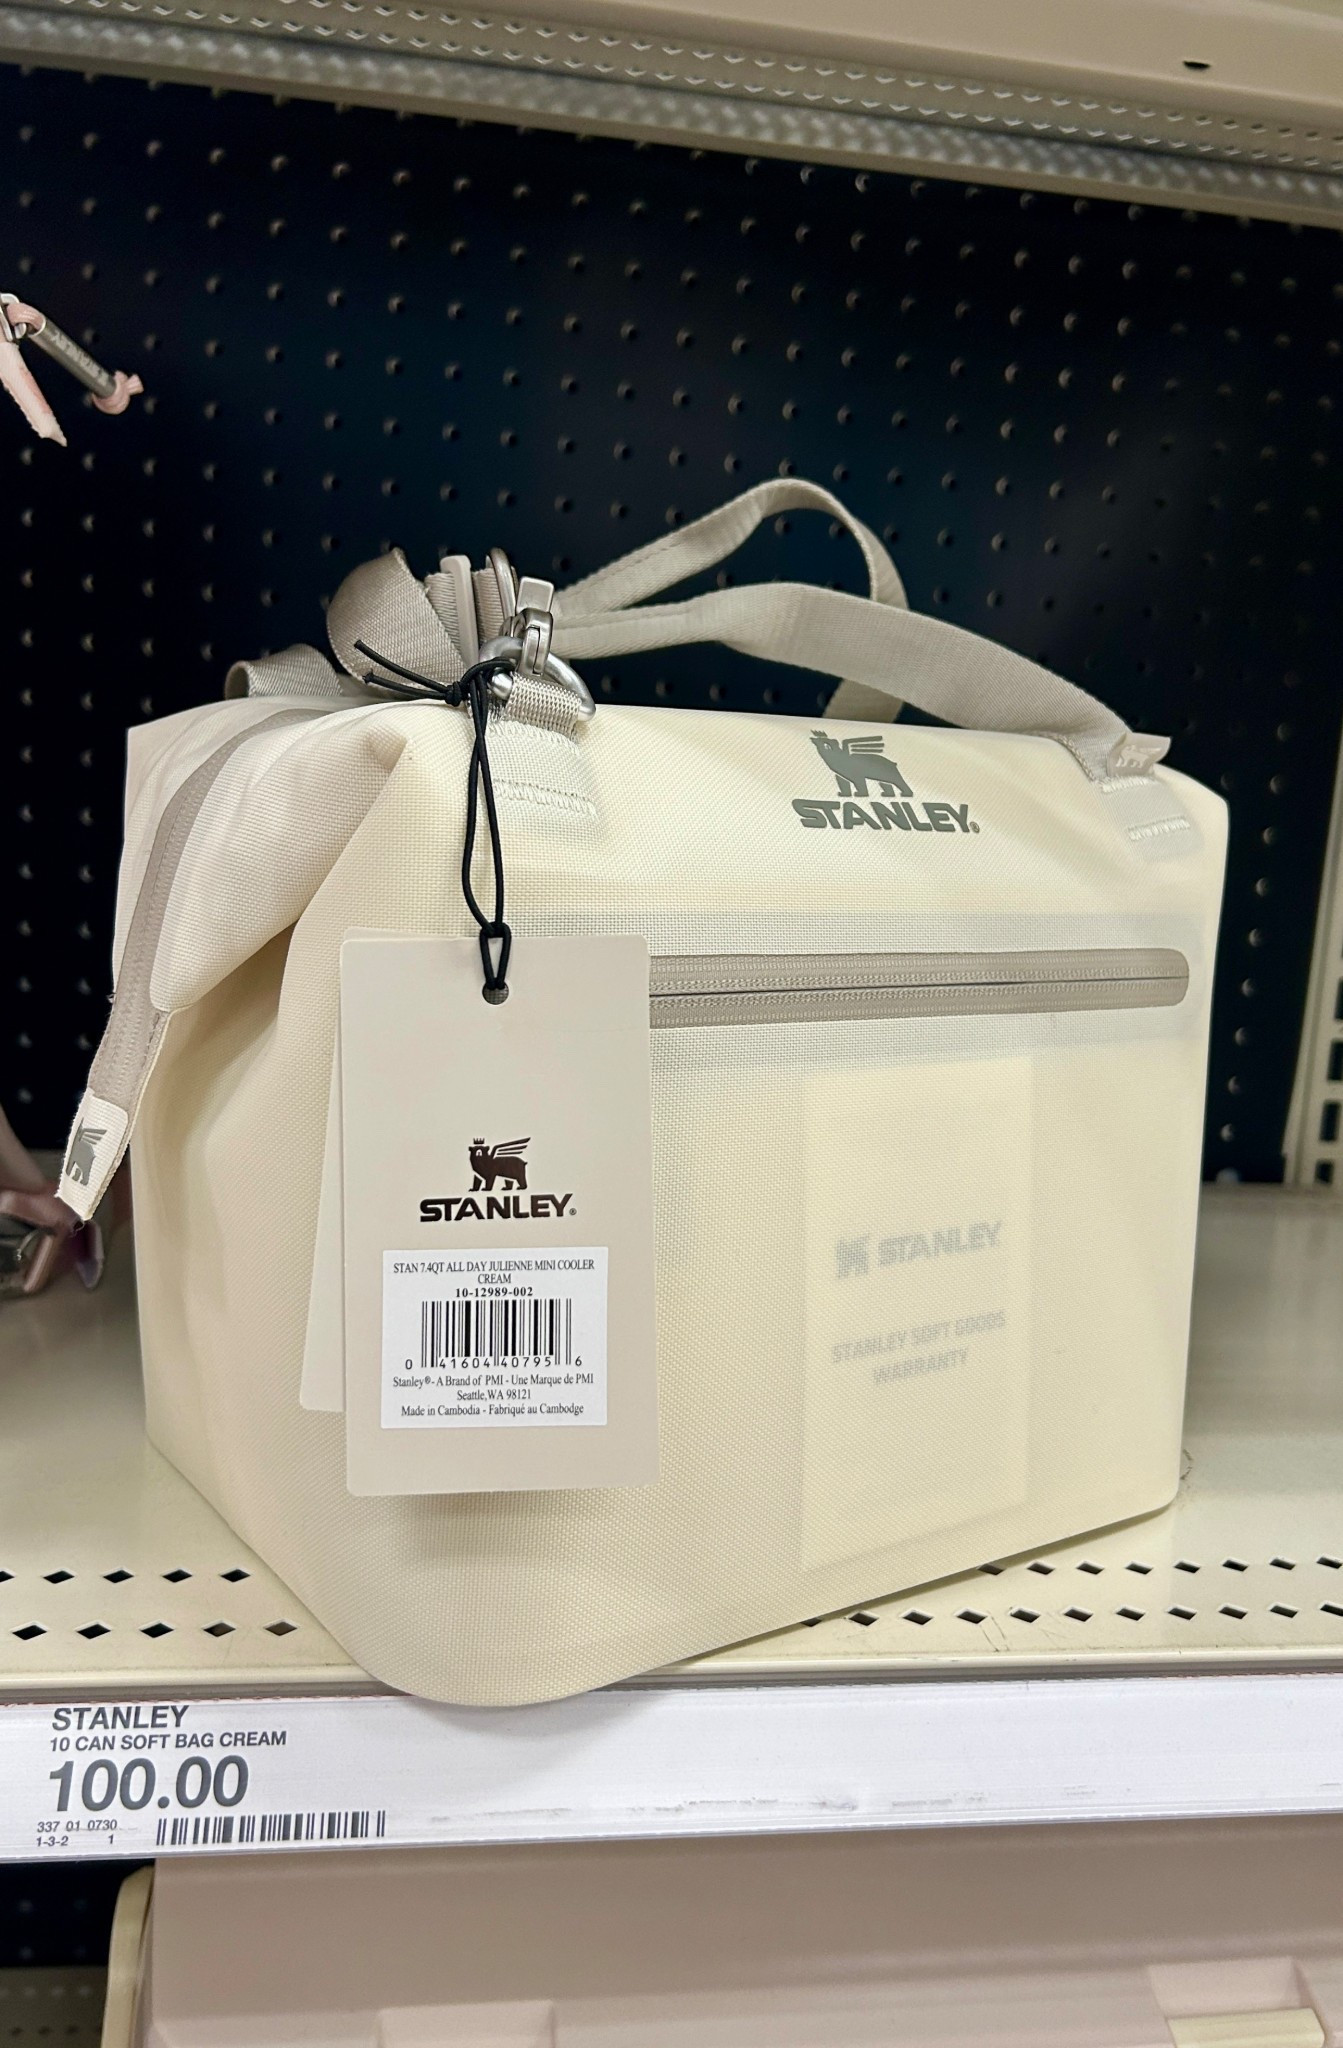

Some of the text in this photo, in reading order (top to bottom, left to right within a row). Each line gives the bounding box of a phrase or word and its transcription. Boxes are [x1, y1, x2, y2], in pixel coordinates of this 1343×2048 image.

[877, 1220, 1002, 1267] STANLEY
[393, 1259, 594, 1274] STAN 7.4QT ALL DAY JULIENNE MINI COOLER
[477, 1273, 511, 1284] CREAM
[455, 1286, 533, 1297] 10-12989-002
[831, 1310, 1006, 1364] STANLEY SOFT GOODS
[405, 1356, 583, 1370] 0 41604 40795 6
[873, 1346, 969, 1385] WARRANTY
[436, 1376, 444, 1386] A
[445, 1375, 471, 1386] Brand
[472, 1374, 482, 1385] of
[485, 1374, 503, 1385] PMI
[511, 1374, 528, 1384] Une
[530, 1373, 562, 1387] Marque
[563, 1373, 574, 1384] de
[576, 1373, 594, 1384] PMI
[506, 1389, 531, 1400] 98121
[401, 1406, 425, 1416] Made
[427, 1404, 435, 1416] in
[437, 1404, 480, 1416] Cambodia
[489, 1403, 525, 1417] Fabriqué
[527, 1406, 538, 1414] au
[539, 1402, 584, 1416] Cambodge
[51, 1705, 190, 1731] STANLEY
[50, 1731, 287, 1751] 10 CAN SOFT BAG CREAM
[49, 1755, 249, 1812] 100.00
[37, 1819, 118, 1833] 337 01 0730
[36, 1834, 114, 1847] 1-3-2 1
